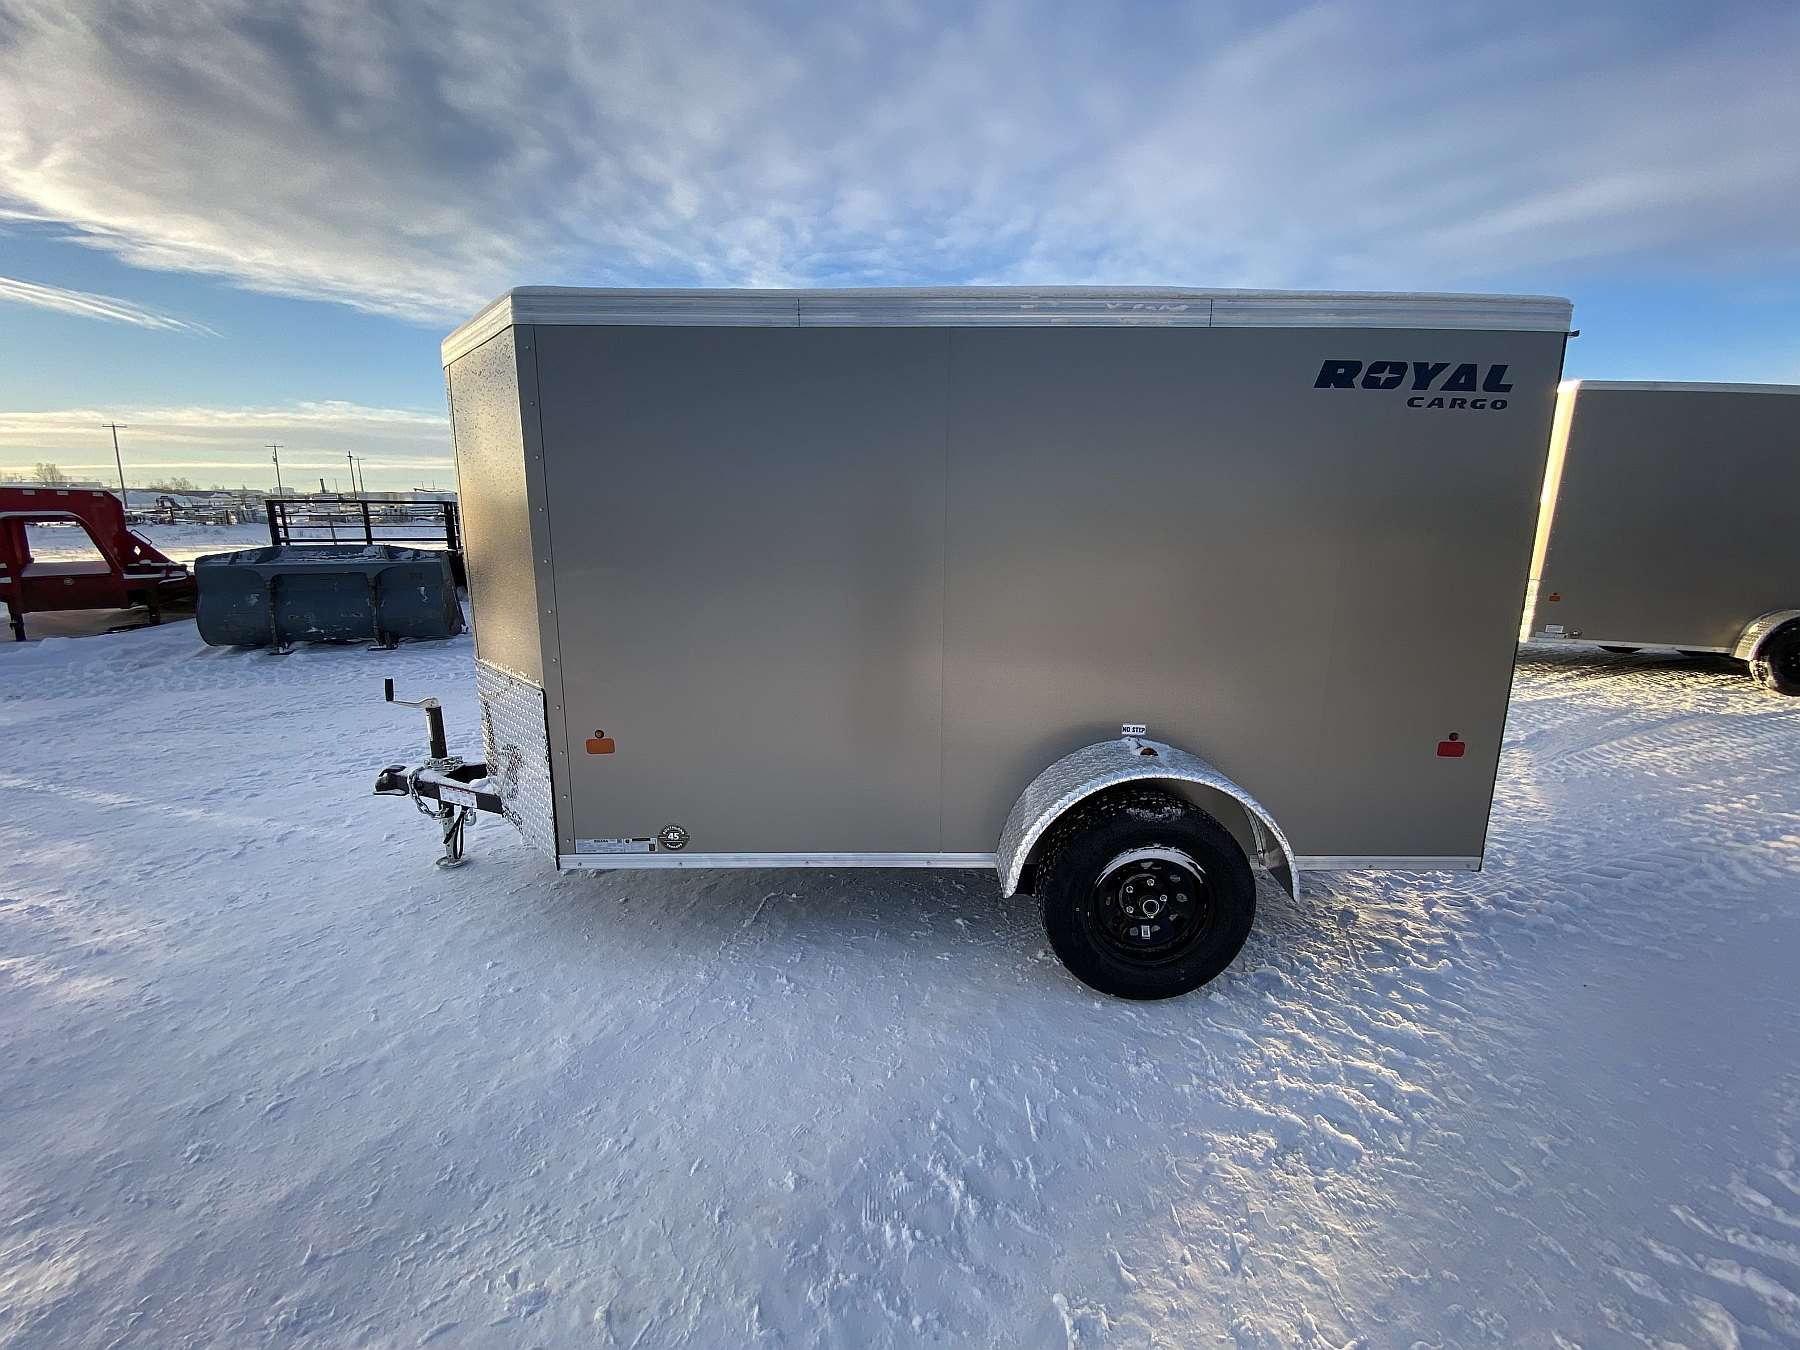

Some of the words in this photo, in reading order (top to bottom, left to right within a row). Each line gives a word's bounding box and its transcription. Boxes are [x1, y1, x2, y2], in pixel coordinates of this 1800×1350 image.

[1313, 359, 1514, 393] ROYAL
[1406, 396, 1509, 411] CARGO
[667, 832, 680, 841] 45
